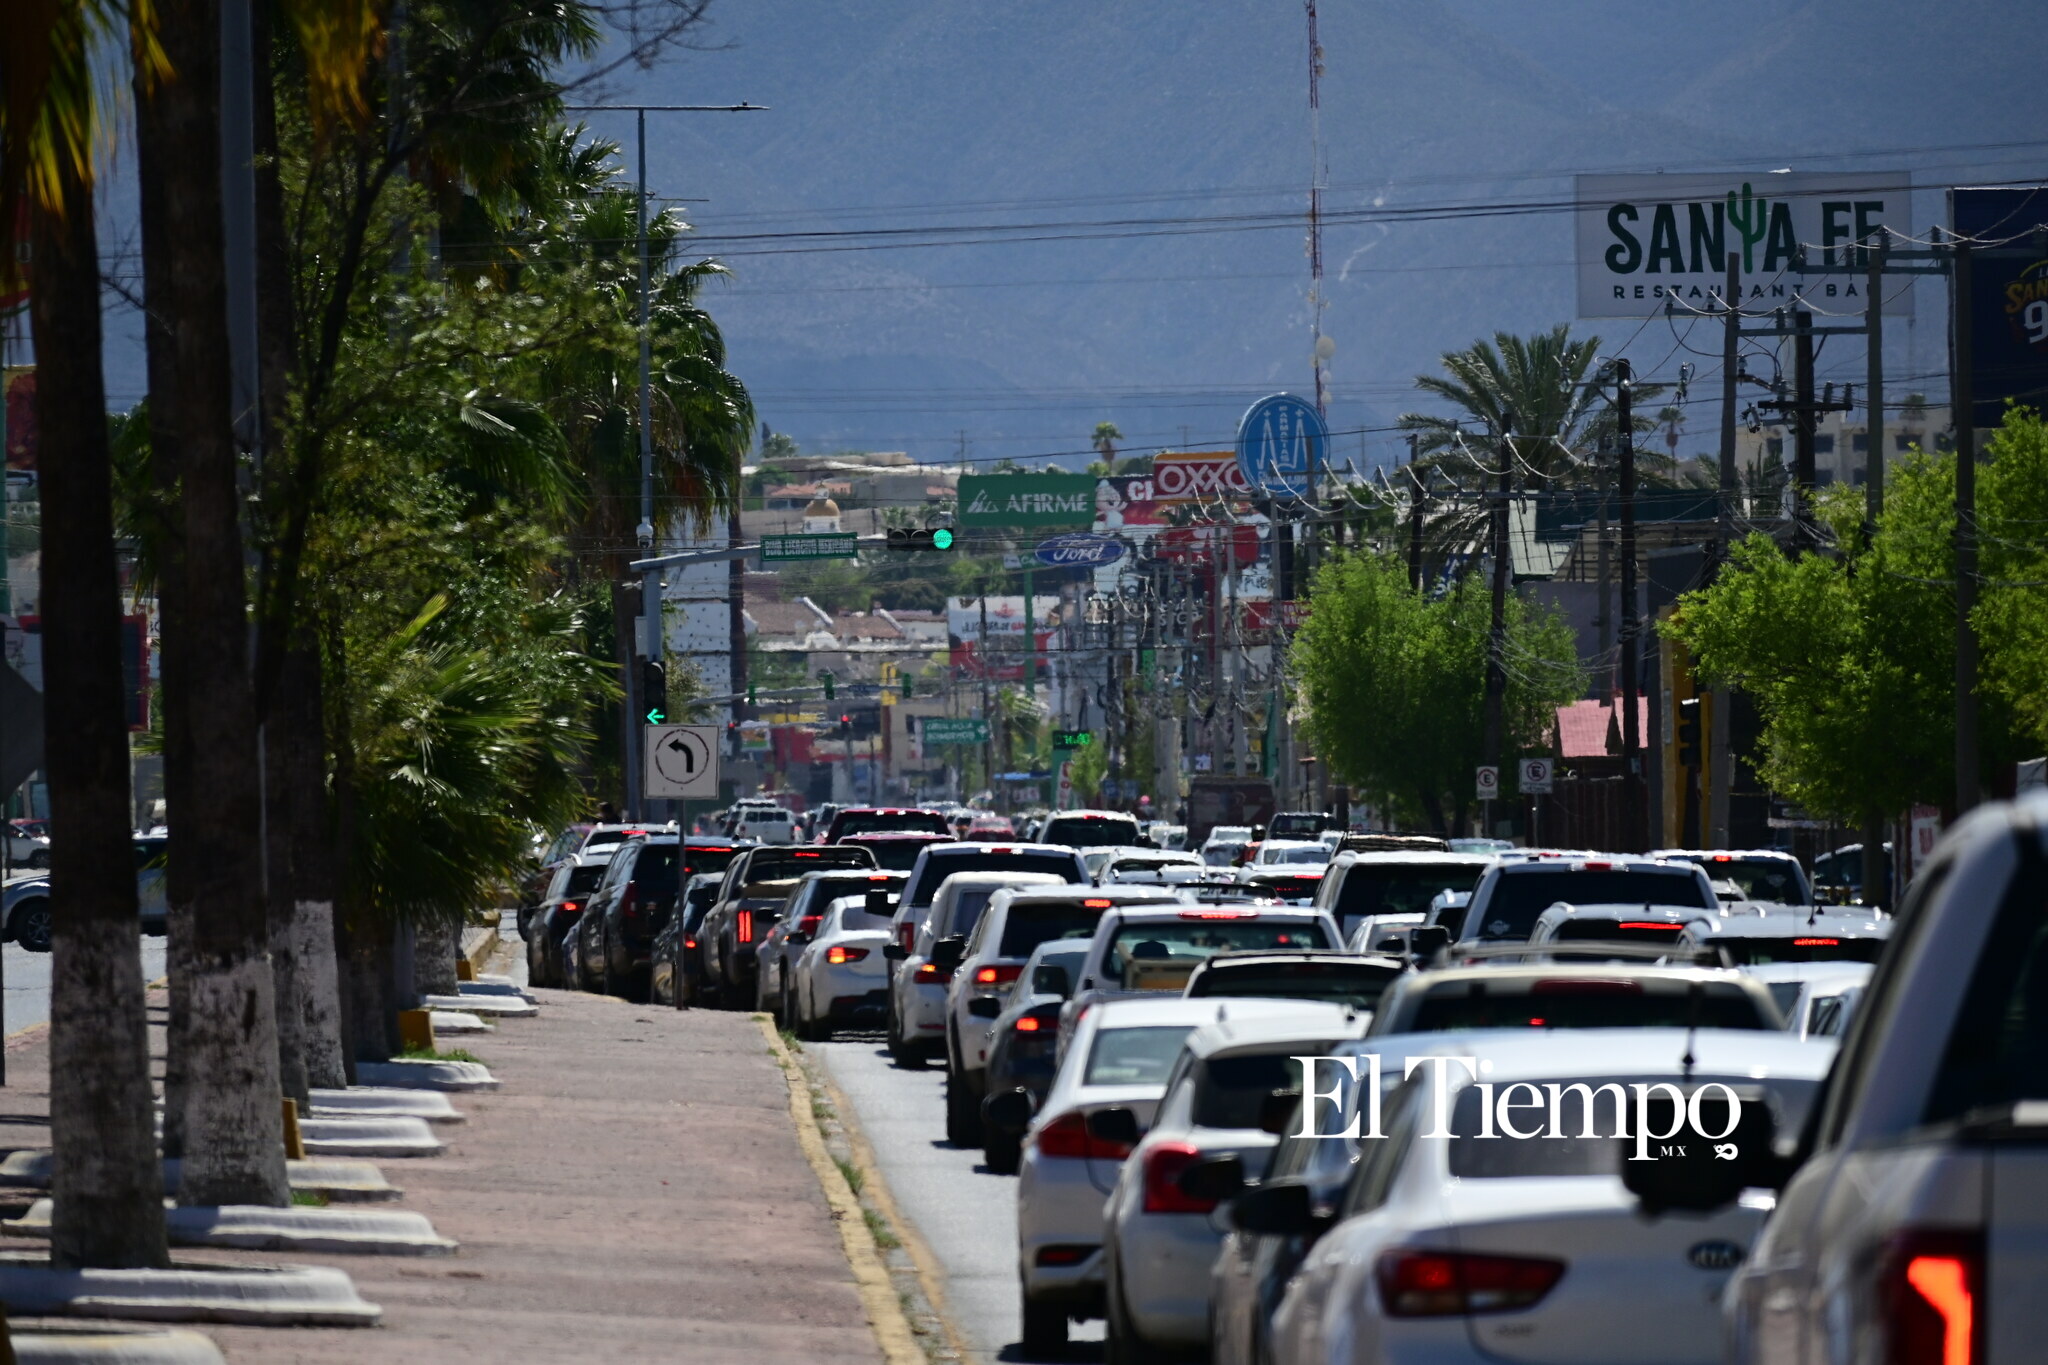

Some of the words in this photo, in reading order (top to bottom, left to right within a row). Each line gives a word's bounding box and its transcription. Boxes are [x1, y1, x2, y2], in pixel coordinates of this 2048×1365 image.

[1826, 284, 1869, 298] BA
[1006, 493, 1088, 513] AFIRME
[1053, 539, 1105, 562] Ford
